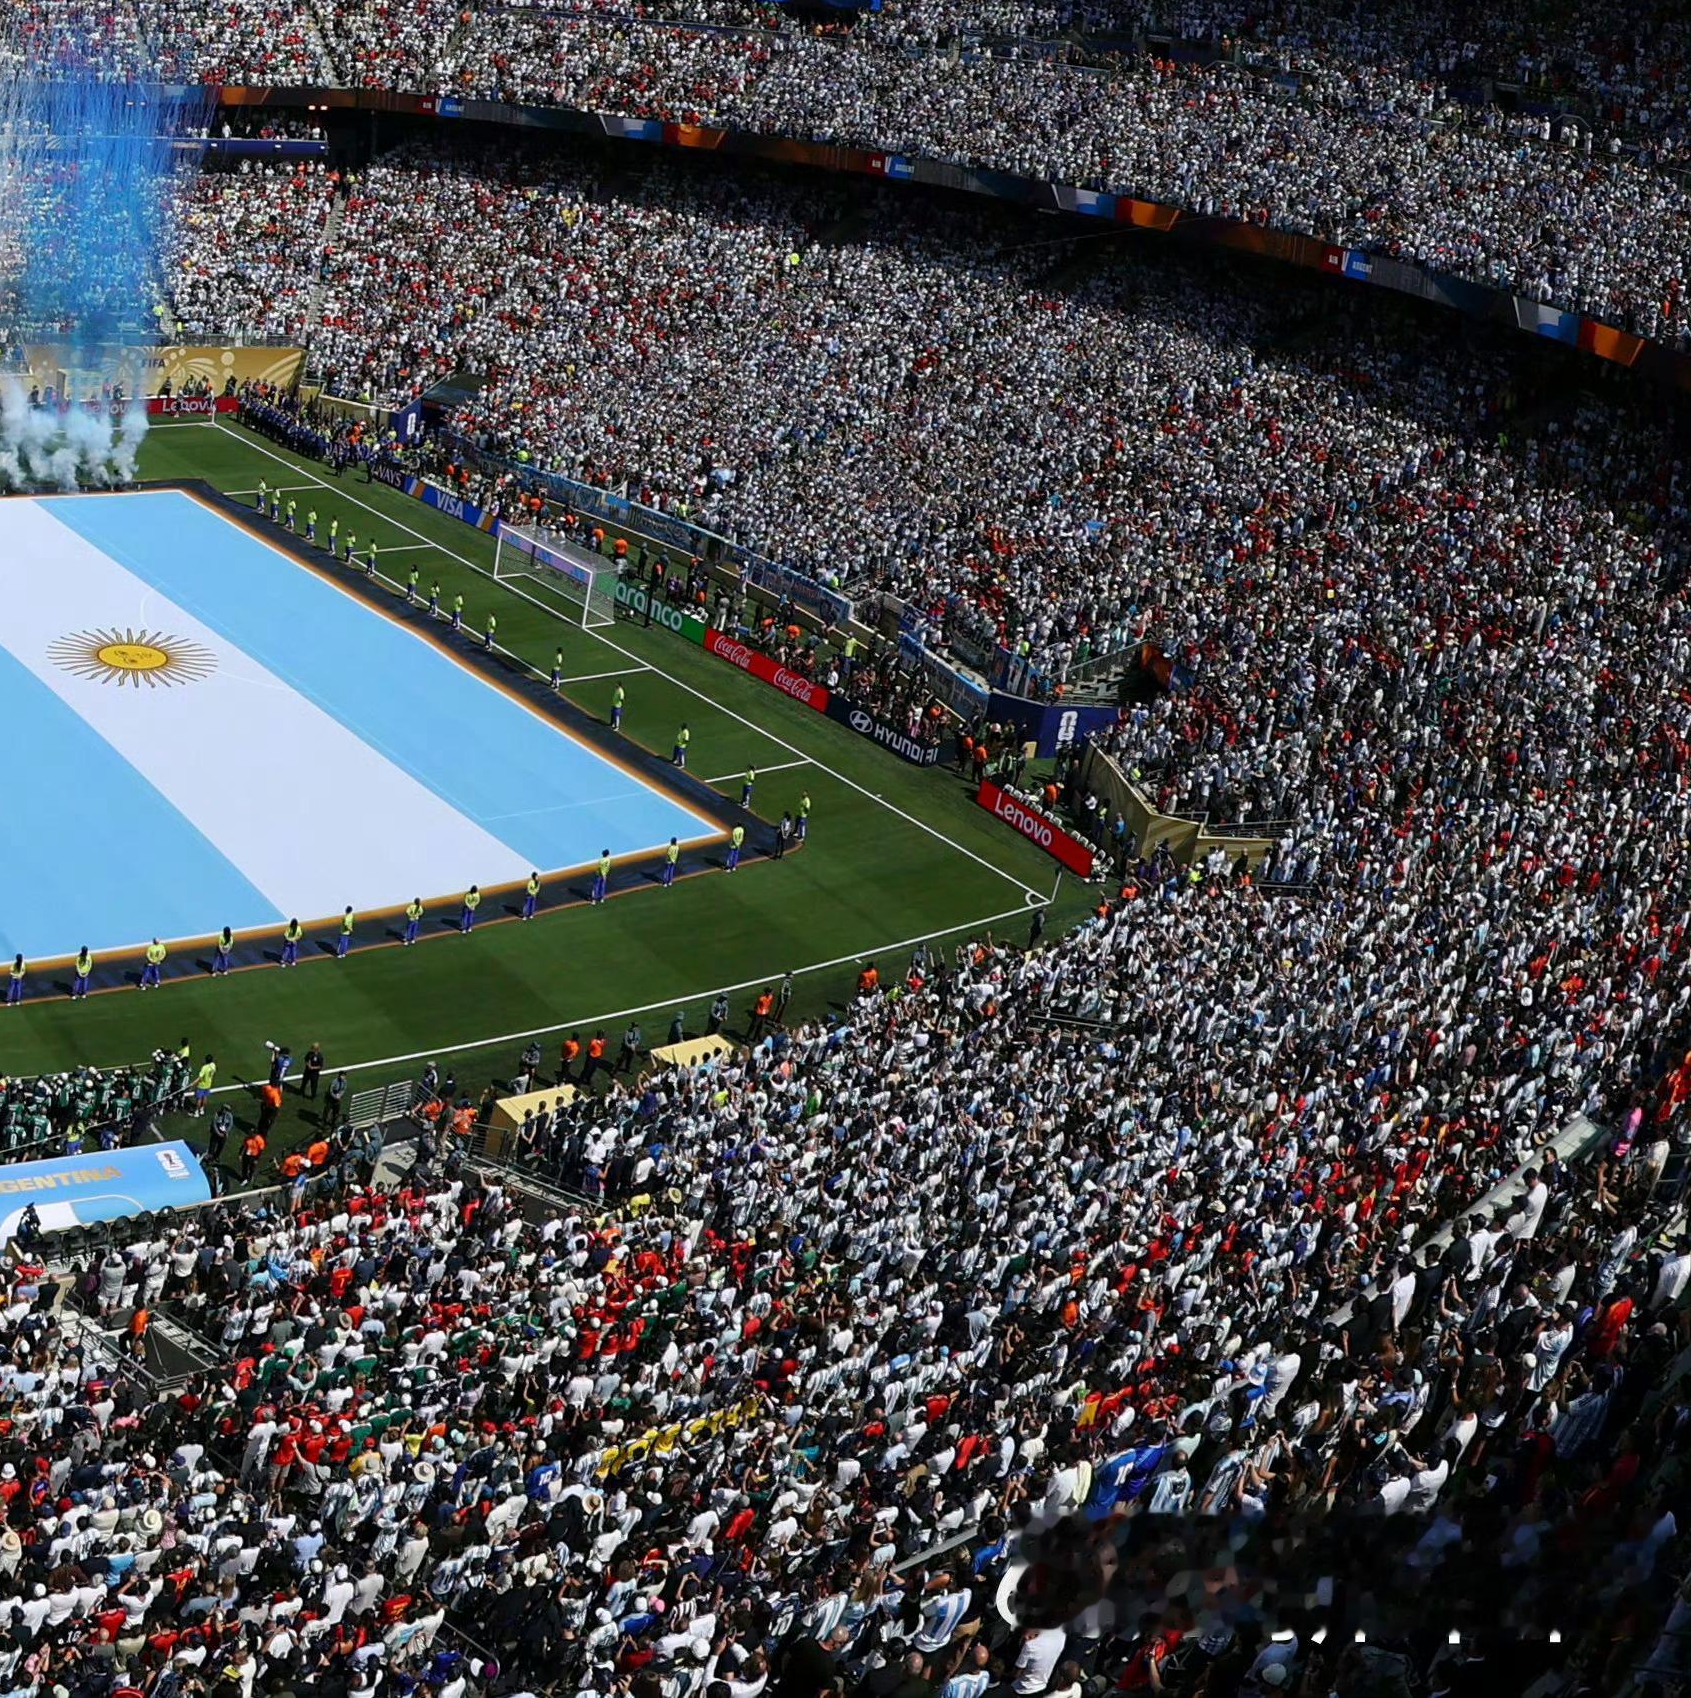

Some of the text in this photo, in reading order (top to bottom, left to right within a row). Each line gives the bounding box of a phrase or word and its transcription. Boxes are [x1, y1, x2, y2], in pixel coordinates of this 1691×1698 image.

[141, 358, 166, 369] FIFA
[435, 489, 464, 520] VISA
[614, 581, 684, 632] aramco
[874, 722, 939, 765] HYUNDAI
[994, 791, 1053, 847] Lenovo
